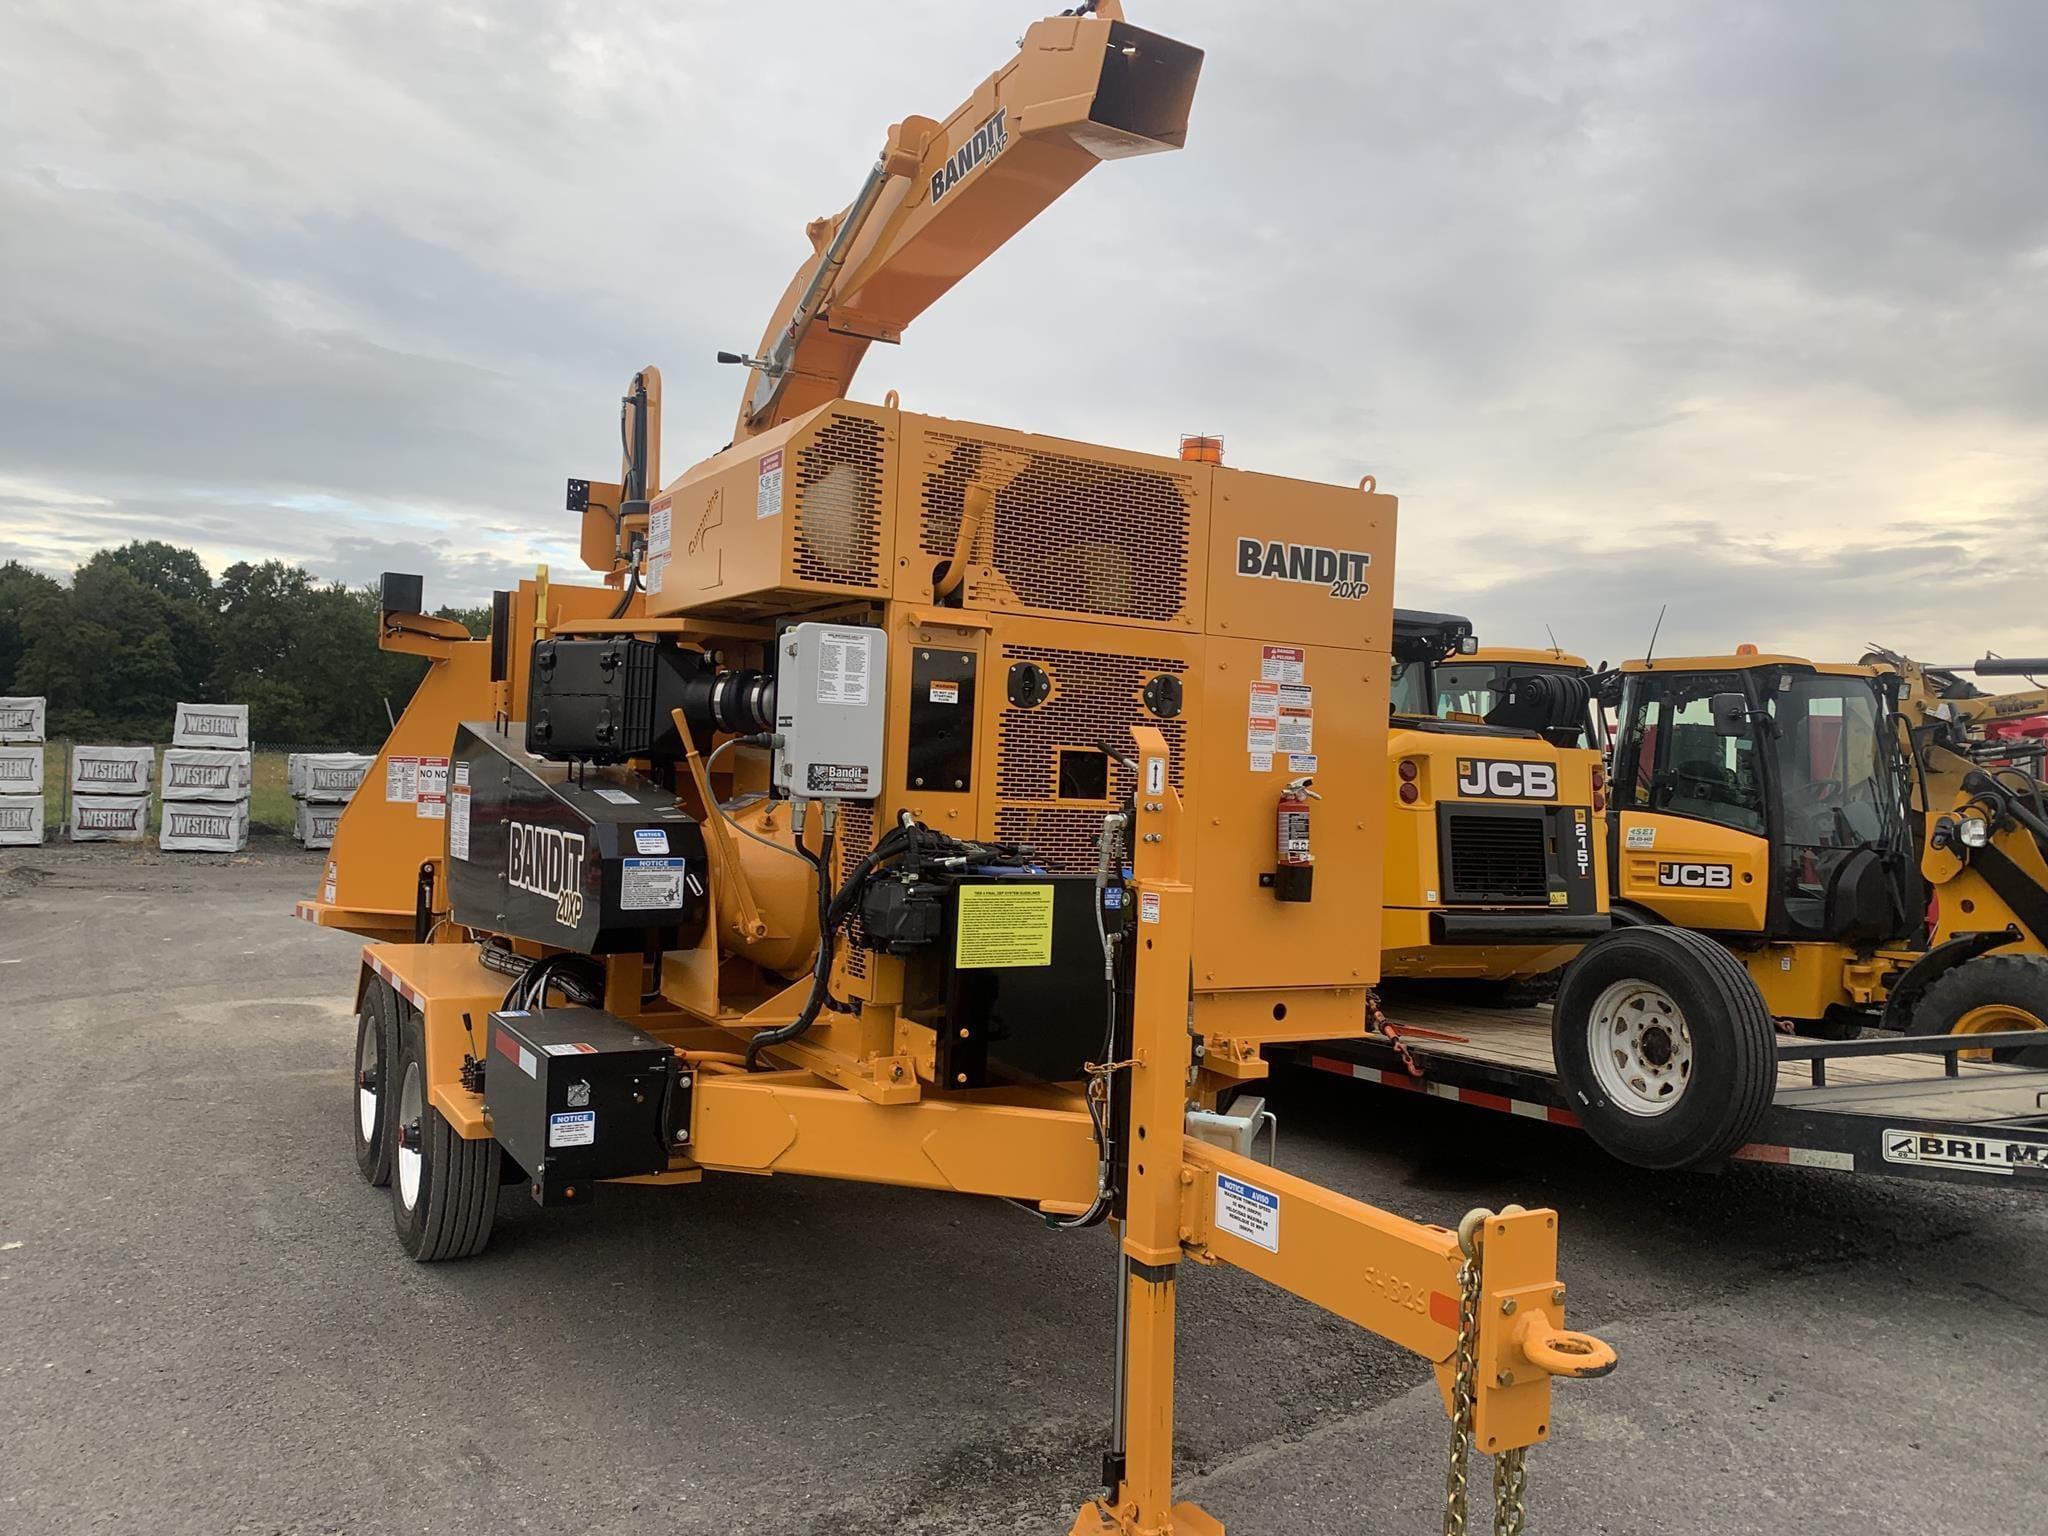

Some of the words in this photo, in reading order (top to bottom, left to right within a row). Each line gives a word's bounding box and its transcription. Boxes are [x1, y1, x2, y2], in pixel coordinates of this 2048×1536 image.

[931, 106, 1007, 205] BANDIT
[985, 131, 1009, 168] 20XP
[1237, 537, 1371, 585] BANDIT
[1330, 581, 1369, 600] 20XP
[187, 715, 235, 735] WESTERN
[83, 762, 133, 779] WESTERN
[175, 766, 227, 786] WESTERN
[420, 770, 433, 778] NO
[435, 770, 448, 779] NO
[829, 766, 862, 778] Bandit
[1459, 761, 1556, 798] JCB
[82, 811, 133, 829] WESTERN
[174, 816, 227, 836] WESTERN
[1575, 823, 1590, 876] 215T
[509, 822, 585, 899] BANDIT
[1660, 864, 1731, 887] JCB
[556, 890, 584, 929] 20XP
[557, 1114, 589, 1124] NOTICE
[1225, 1180, 1244, 1194] NOTICE
[1252, 1191, 1269, 1205] AVISO
